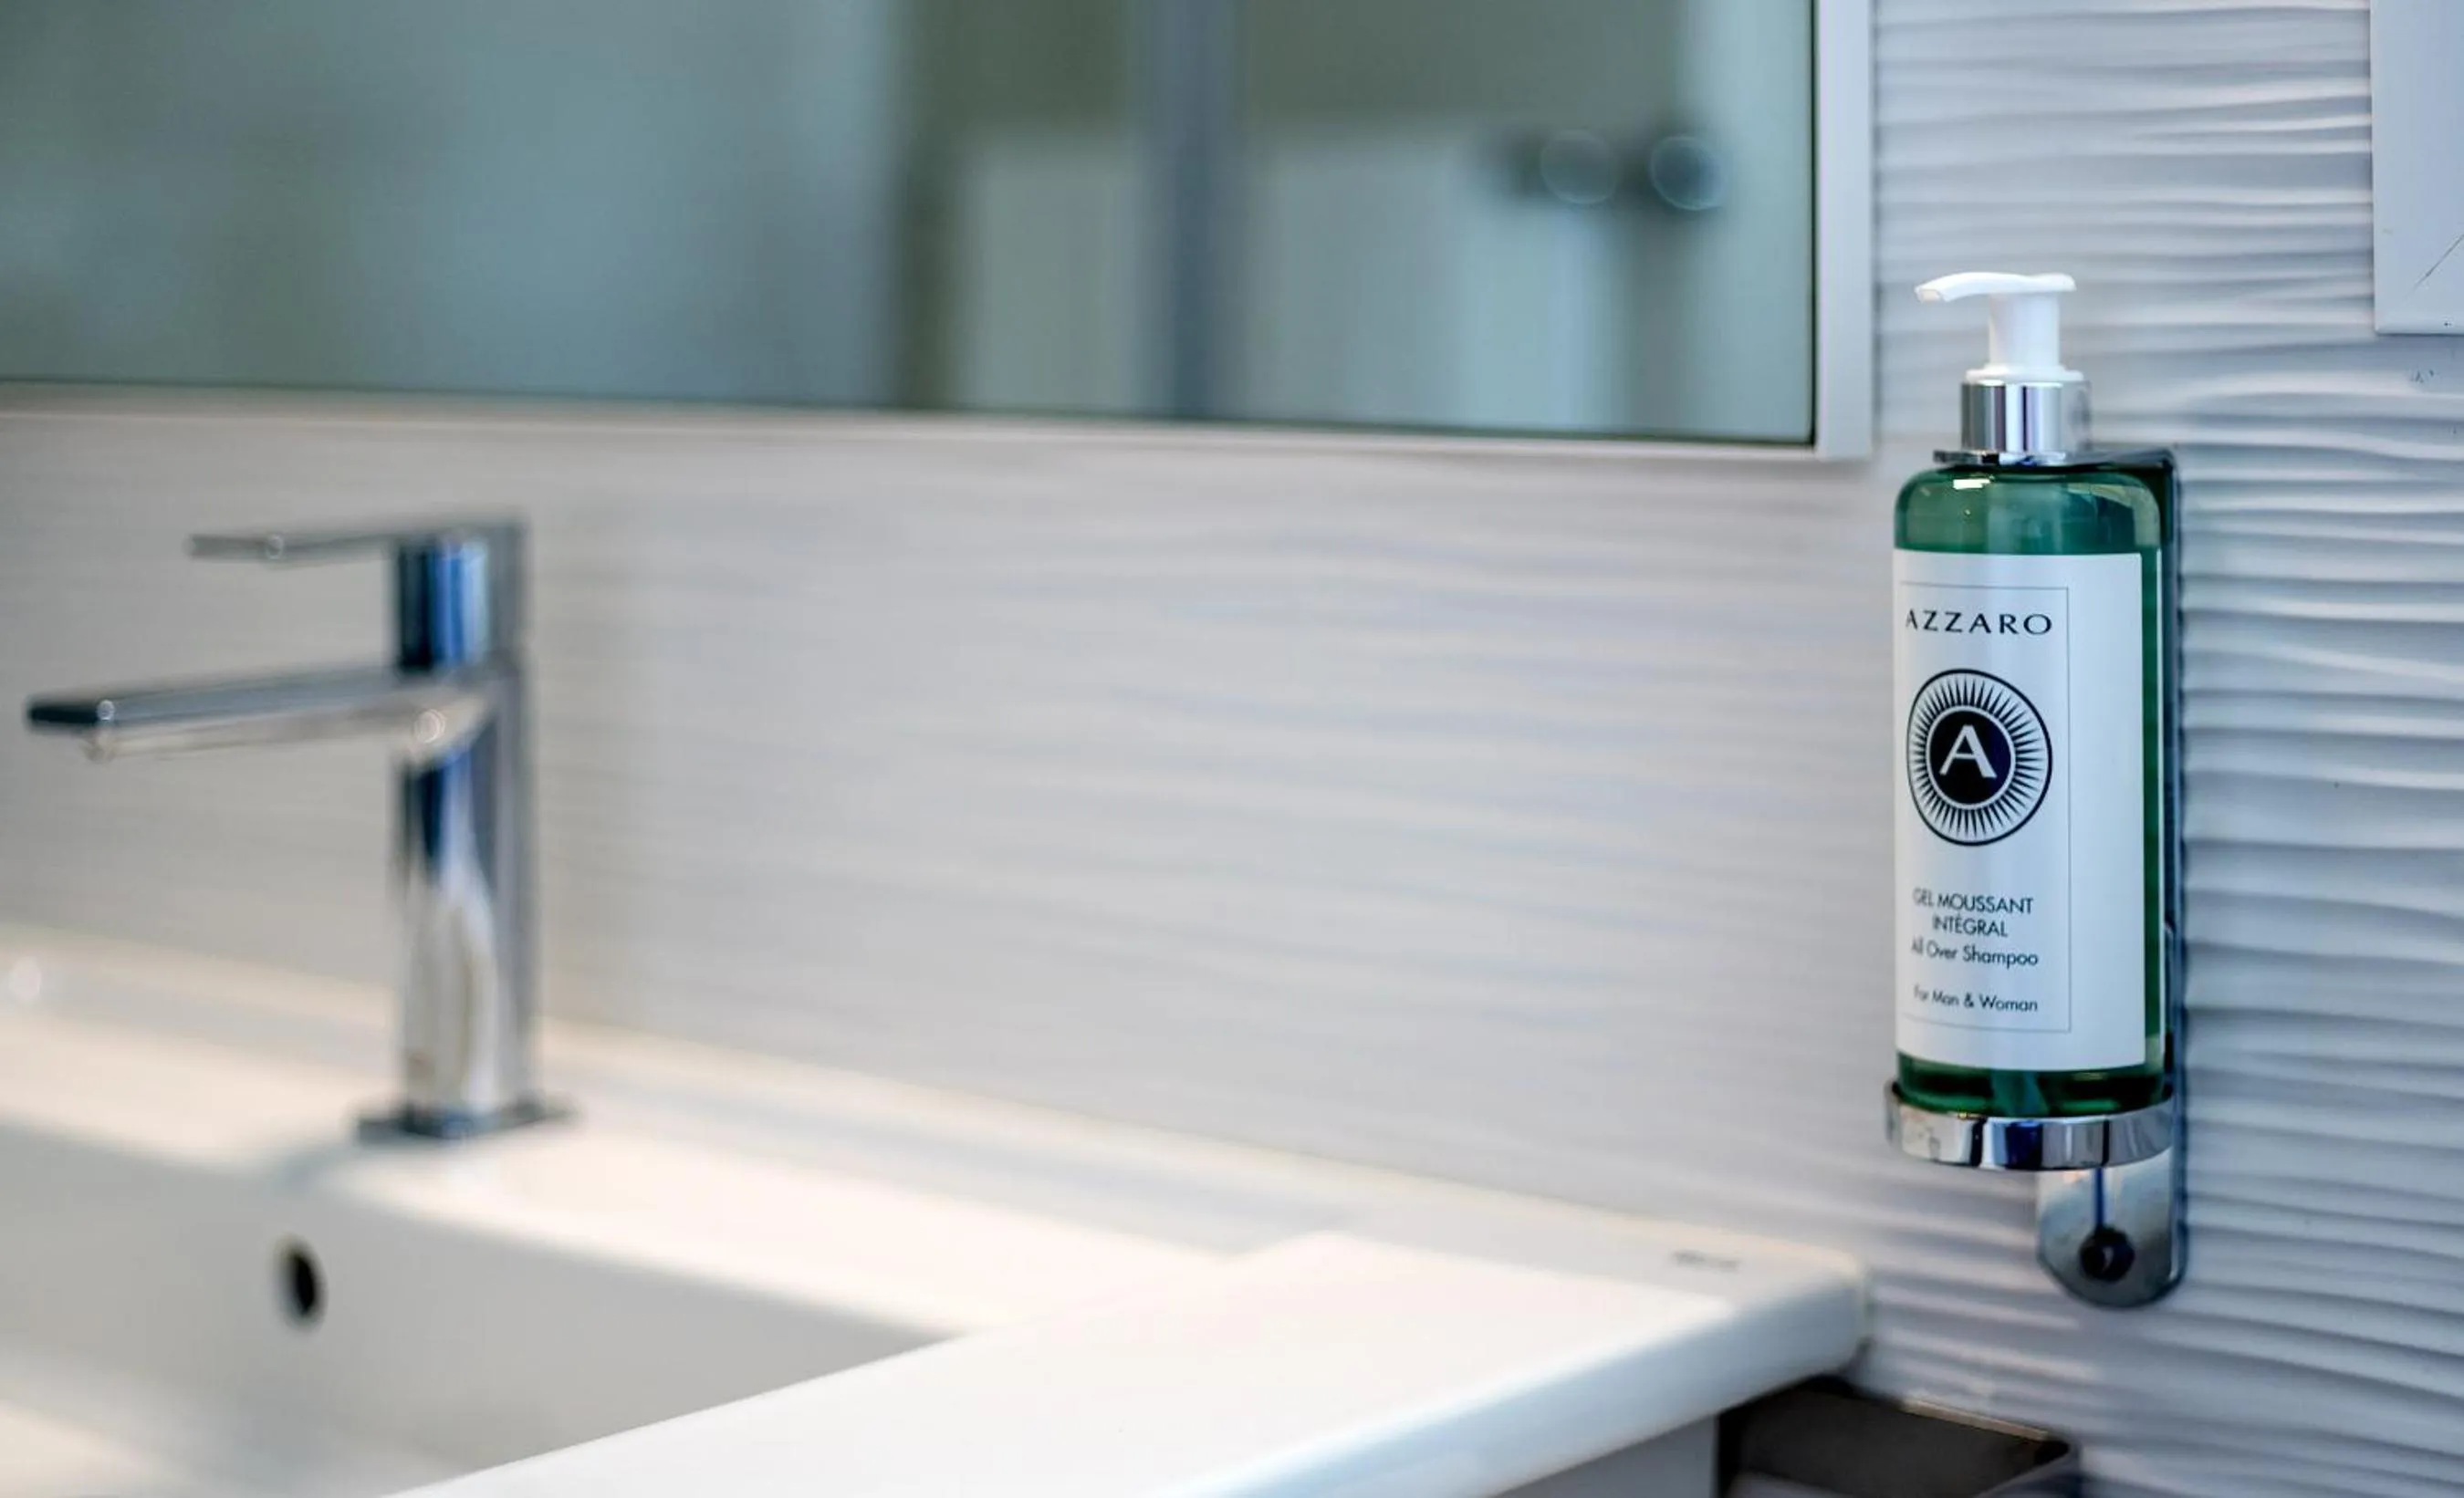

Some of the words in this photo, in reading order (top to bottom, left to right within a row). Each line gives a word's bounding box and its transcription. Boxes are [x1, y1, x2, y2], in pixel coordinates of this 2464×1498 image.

[1905, 609, 2052, 635] AZZARO
[1939, 724, 1998, 779] A
[1913, 888, 1934, 907] GEL
[1937, 893, 2034, 914] MOUSSANT
[1933, 913, 2009, 938] INTÉGRAL
[1911, 936, 1924, 955] All
[1926, 940, 1958, 959] Over
[1963, 943, 2039, 970] Shampoo
[1914, 984, 1928, 1001] For
[1933, 991, 1959, 1006] Man
[1964, 993, 1974, 1008] &
[1979, 994, 2038, 1012] Woman
